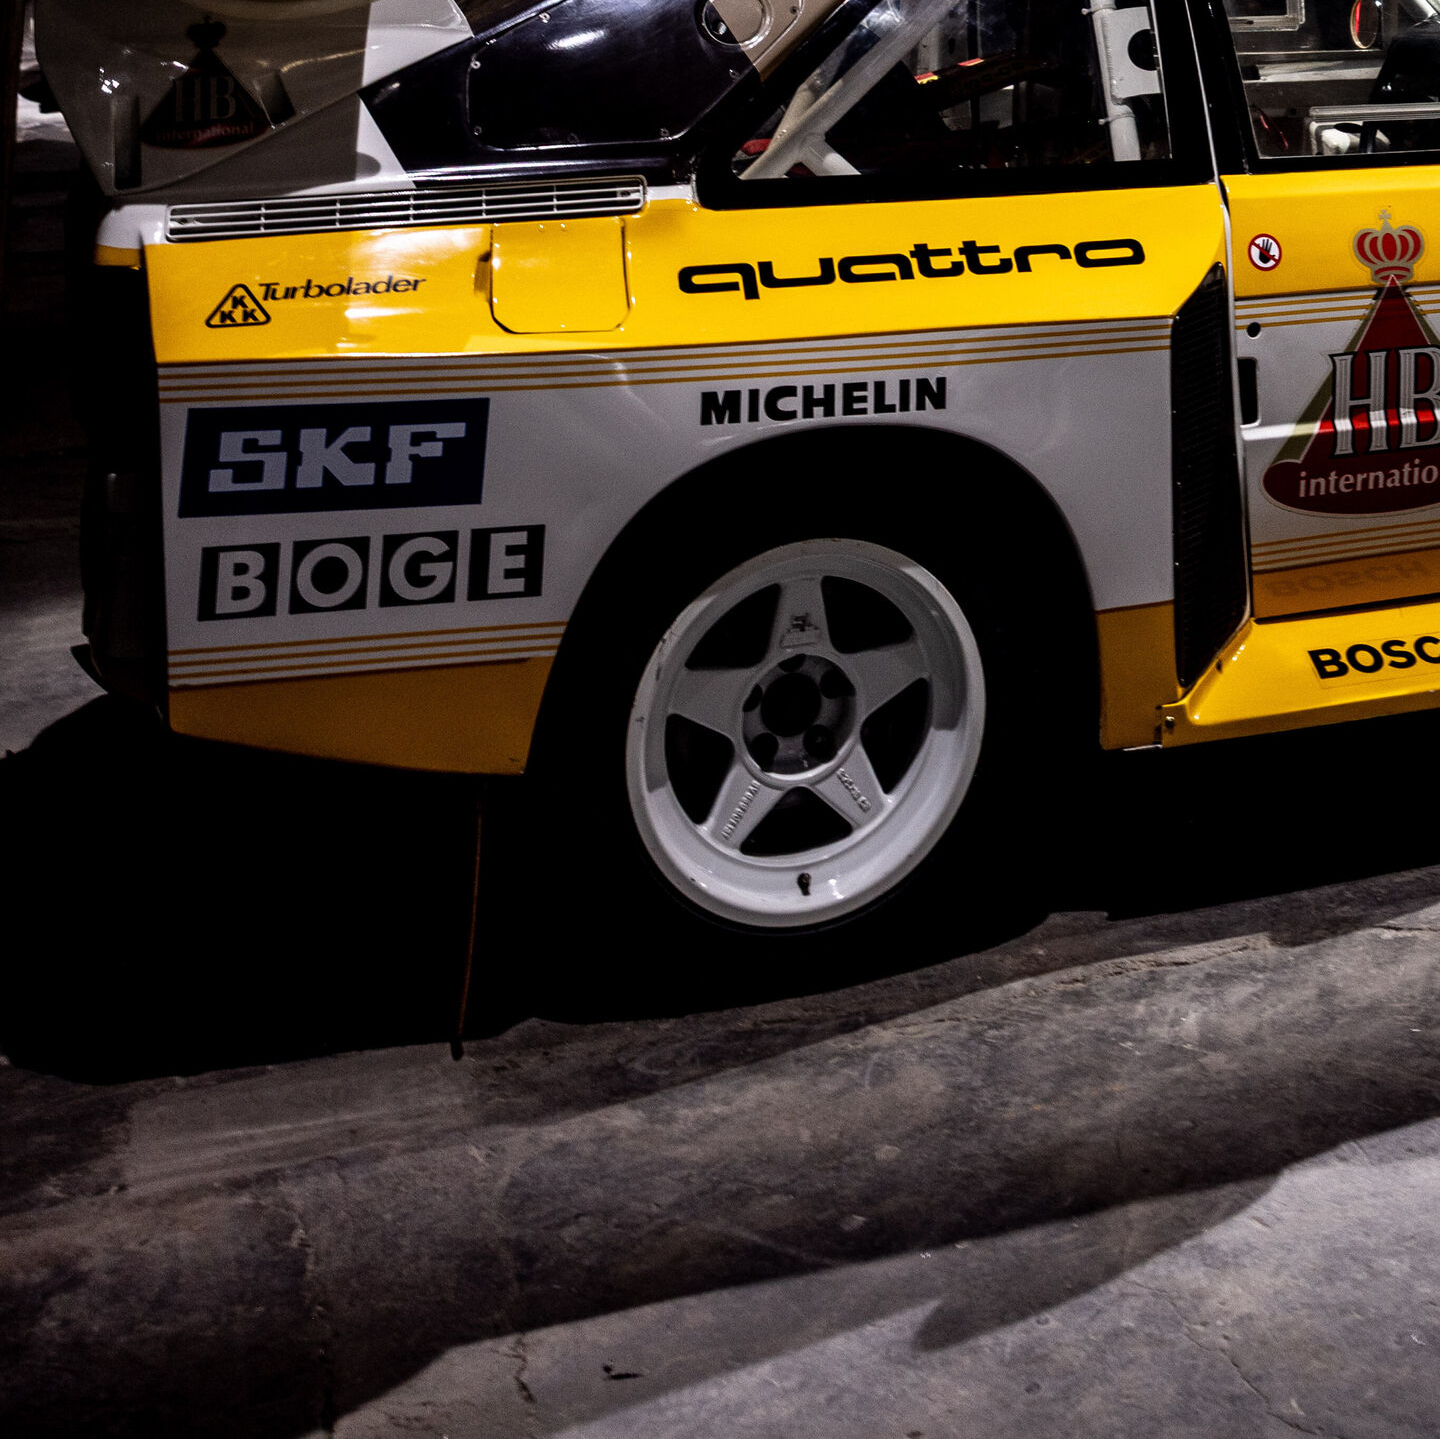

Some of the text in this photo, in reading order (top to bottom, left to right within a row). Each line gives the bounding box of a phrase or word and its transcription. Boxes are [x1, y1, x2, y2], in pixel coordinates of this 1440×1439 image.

[258, 275, 426, 301] Turbolader
[678, 238, 1146, 300] quattro
[699, 375, 948, 427] MICHELIN
[206, 421, 468, 494] SKF
[213, 529, 530, 617] BOGE
